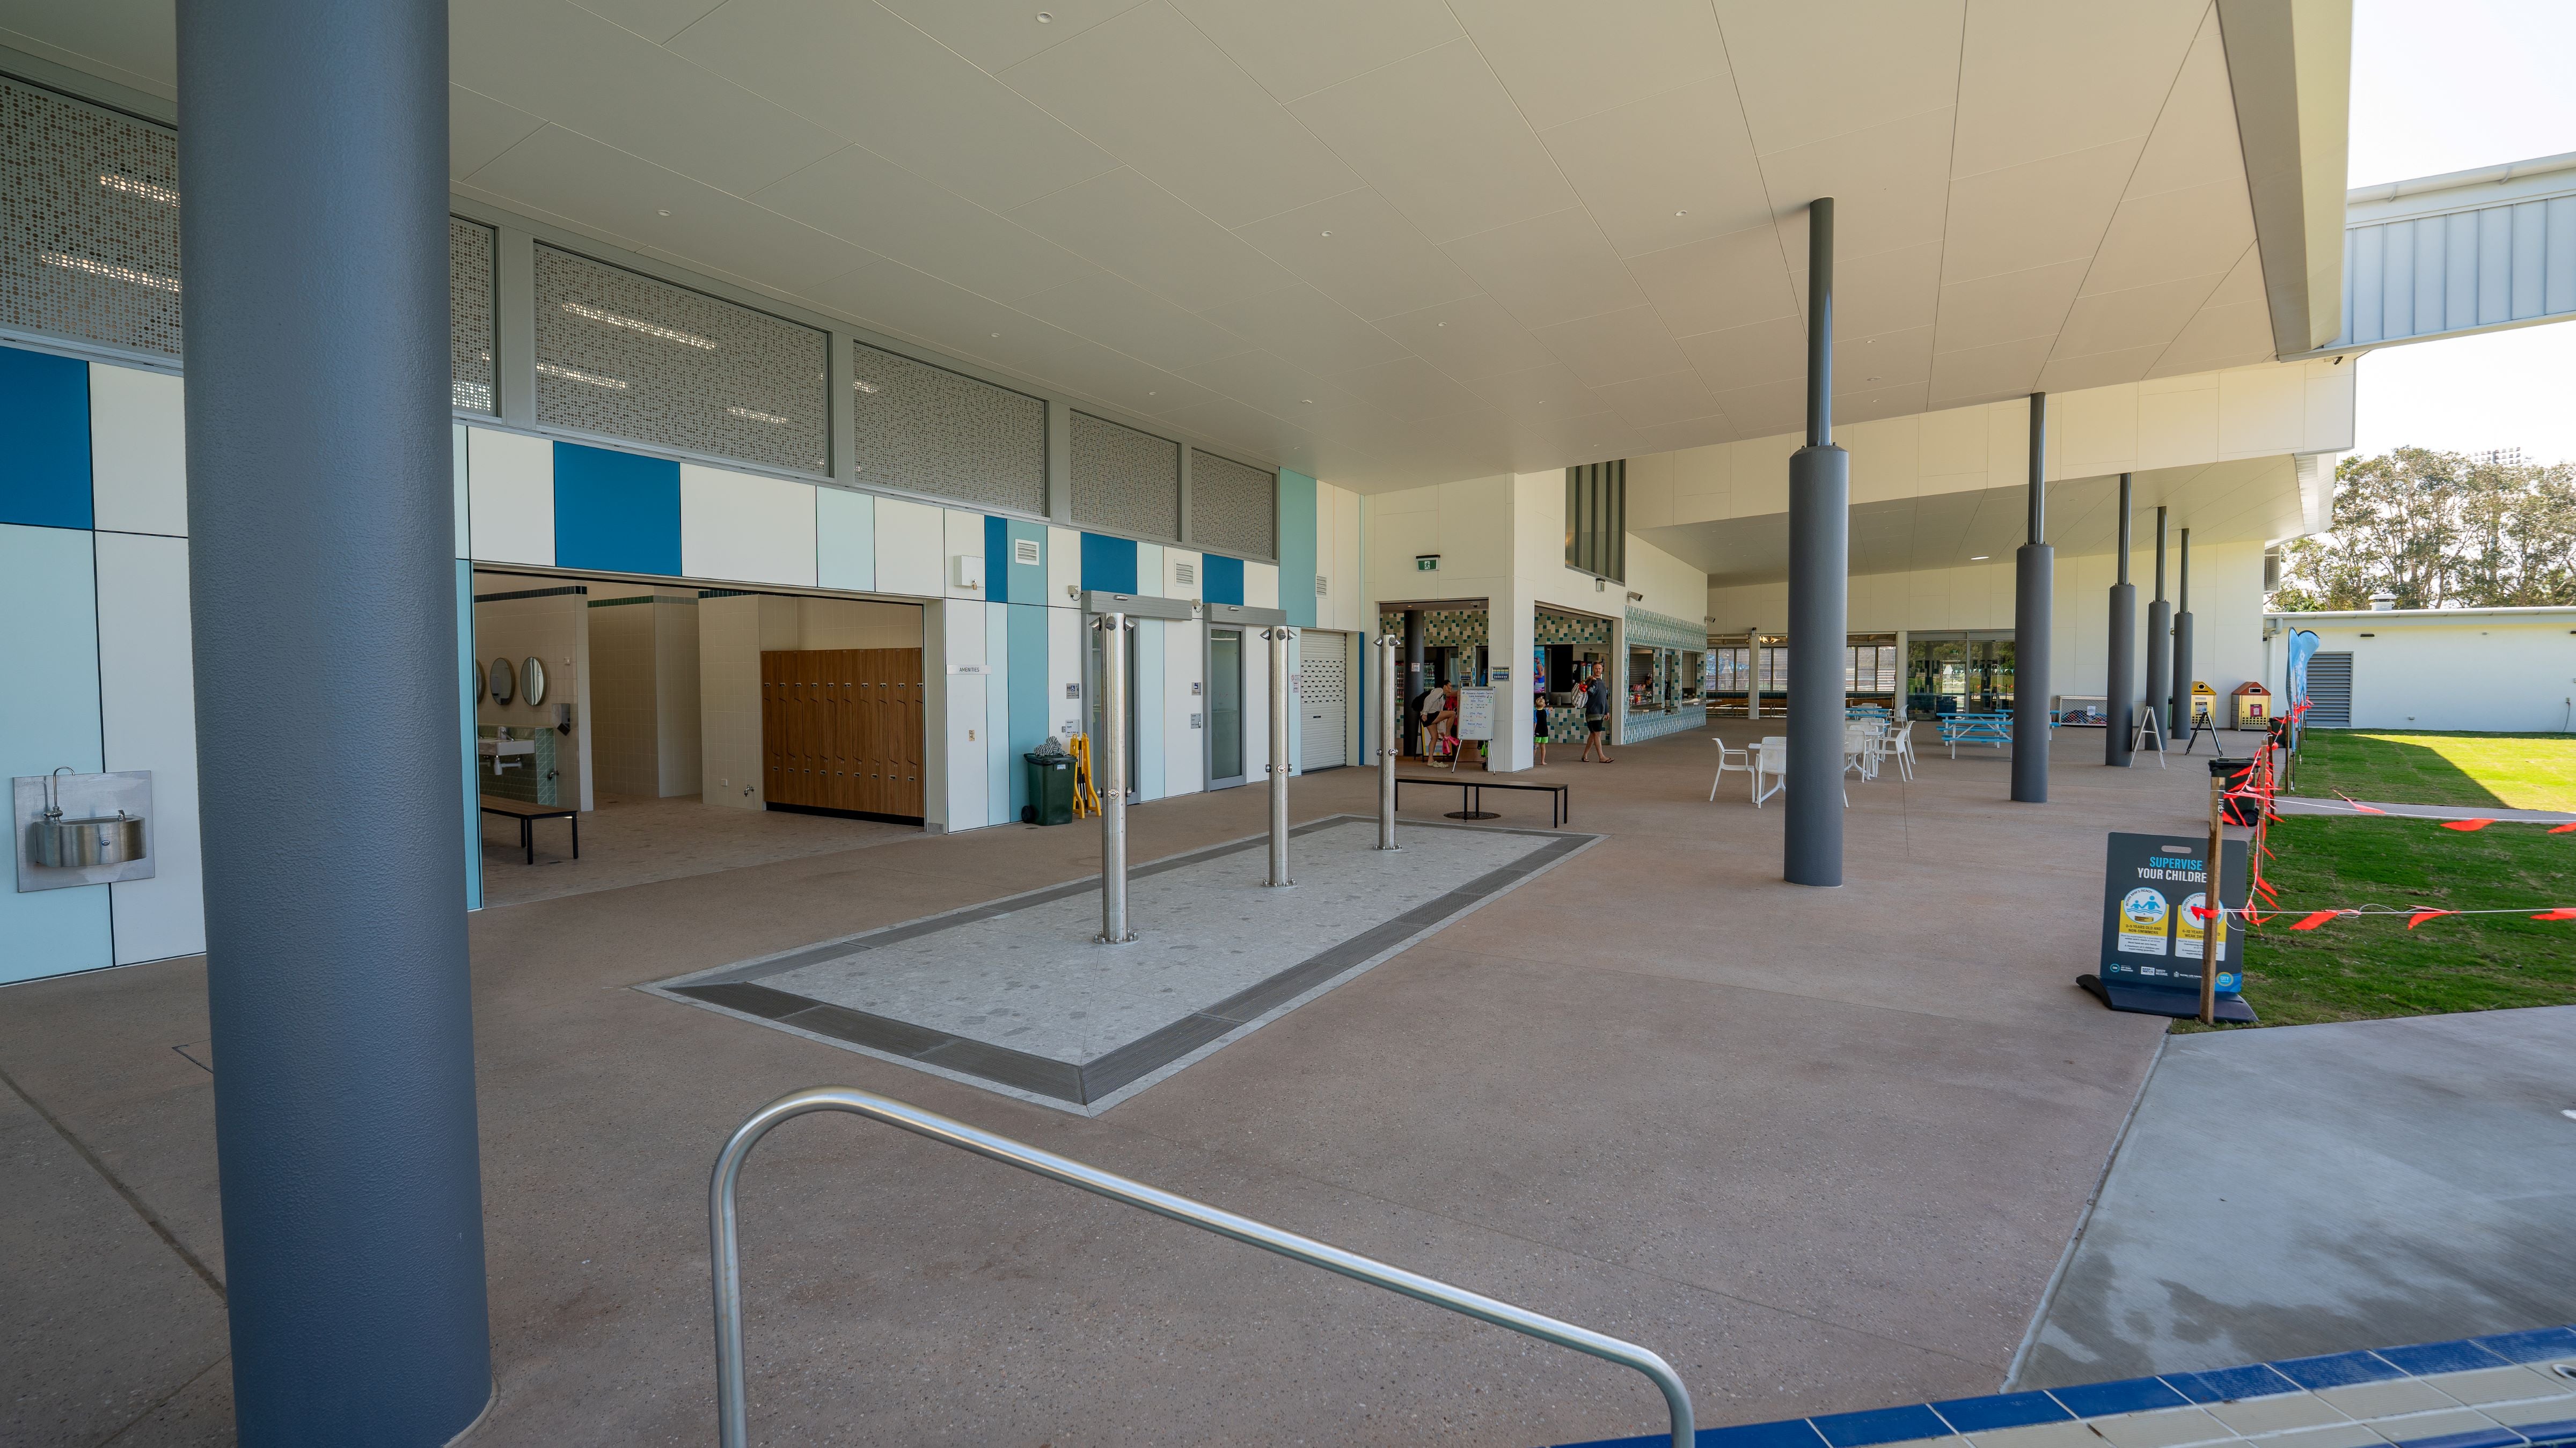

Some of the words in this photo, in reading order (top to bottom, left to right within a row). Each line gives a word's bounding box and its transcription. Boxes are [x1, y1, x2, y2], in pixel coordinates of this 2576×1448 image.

[2149, 857, 2202, 870] SUPERVISE
[2138, 868, 2163, 879] YOUR
[2165, 870, 2207, 883] CHILDRE
